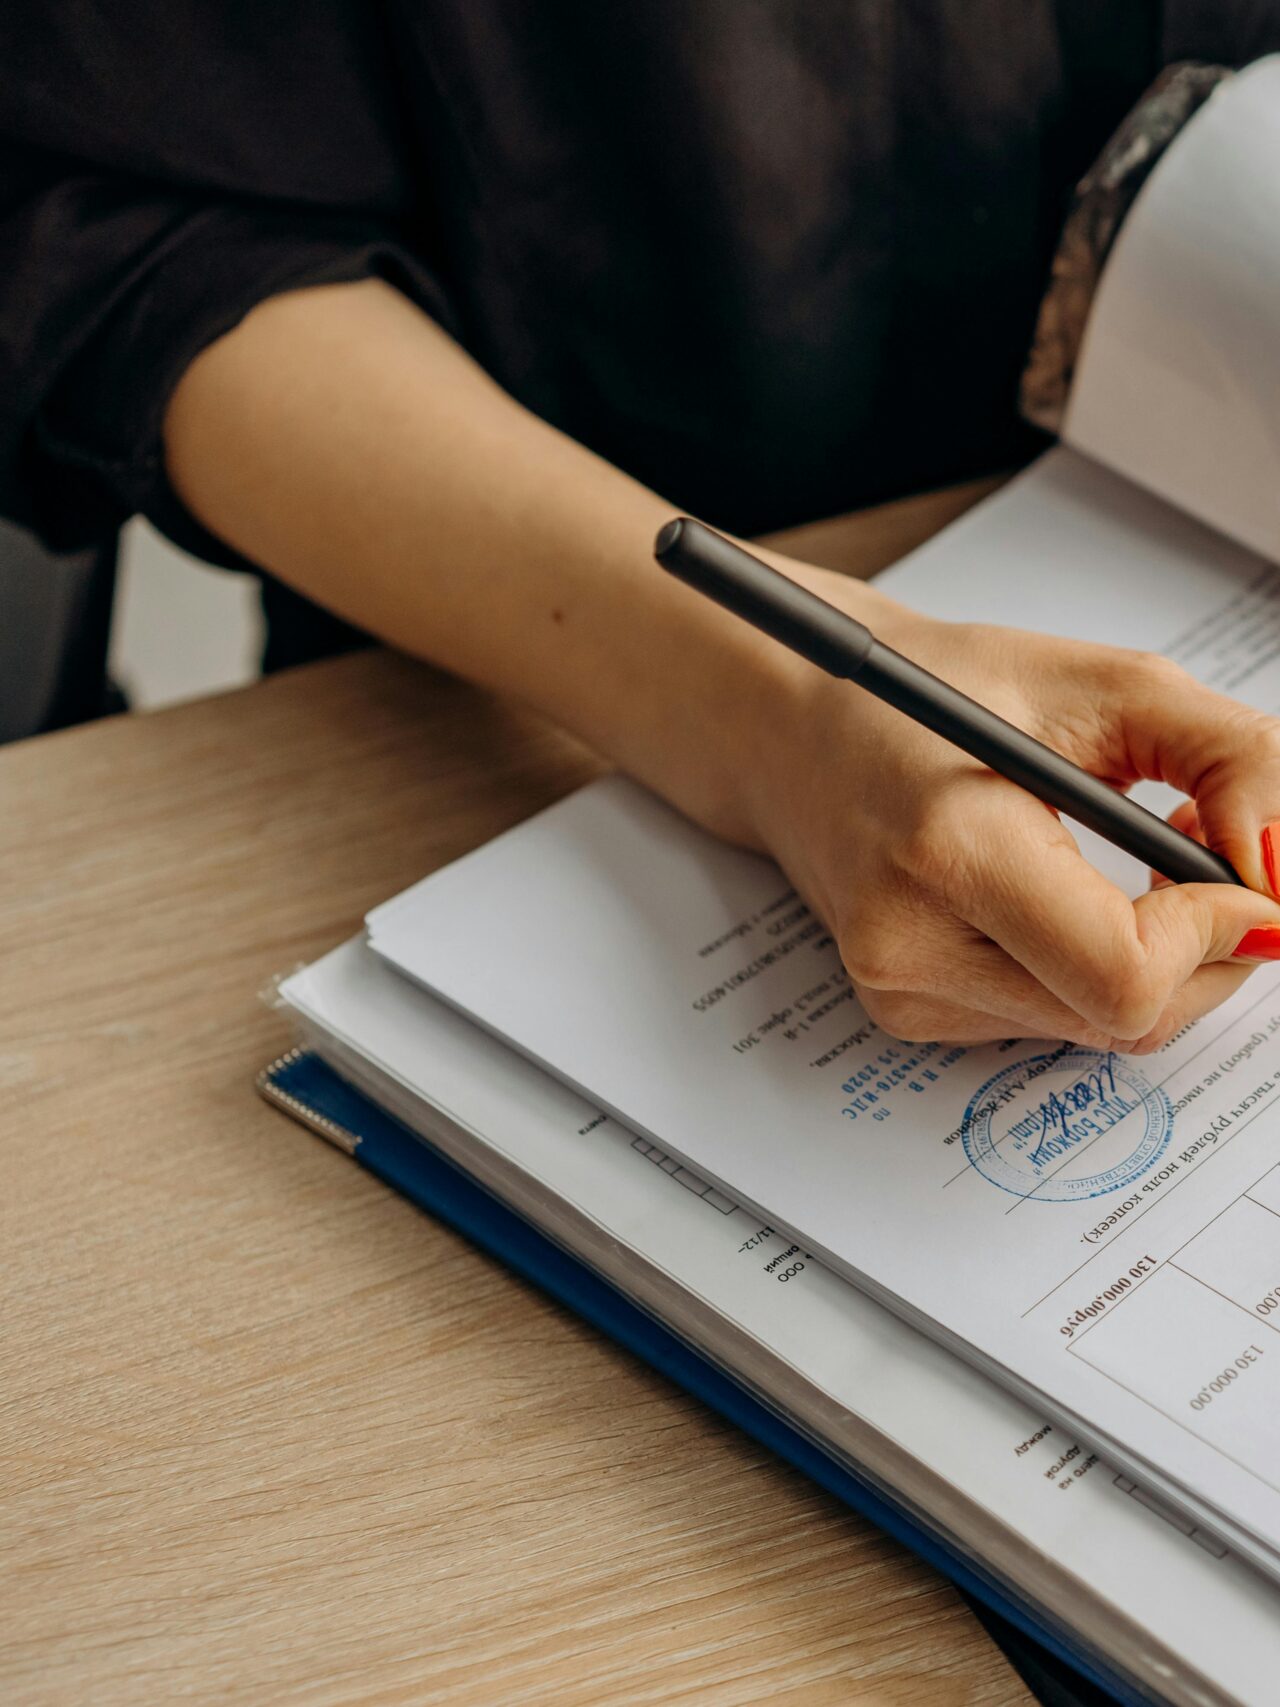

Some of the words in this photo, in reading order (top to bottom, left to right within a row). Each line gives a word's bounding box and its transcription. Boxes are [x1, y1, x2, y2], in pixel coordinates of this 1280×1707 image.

[732, 1032, 760, 1053] 301
[1217, 1032, 1268, 1072] (работ)
[1202, 1070, 1221, 1086] не
[871, 1107, 891, 1121] по
[1229, 1081, 1275, 1118] тысяч
[1177, 1114, 1232, 1163] рублей
[1141, 1162, 1179, 1192] ноль
[1080, 1192, 1143, 1243] копеек).
[762, 1243, 803, 1273] оящий
[777, 1261, 804, 1282] ООО
[1128, 1255, 1157, 1278] 130
[1059, 1277, 1131, 1338] 000,00руб
[1234, 1344, 1263, 1369] 130
[1189, 1367, 1238, 1410] 000,00
[1013, 1424, 1052, 1457] между
[1043, 1442, 1085, 1480] другой
